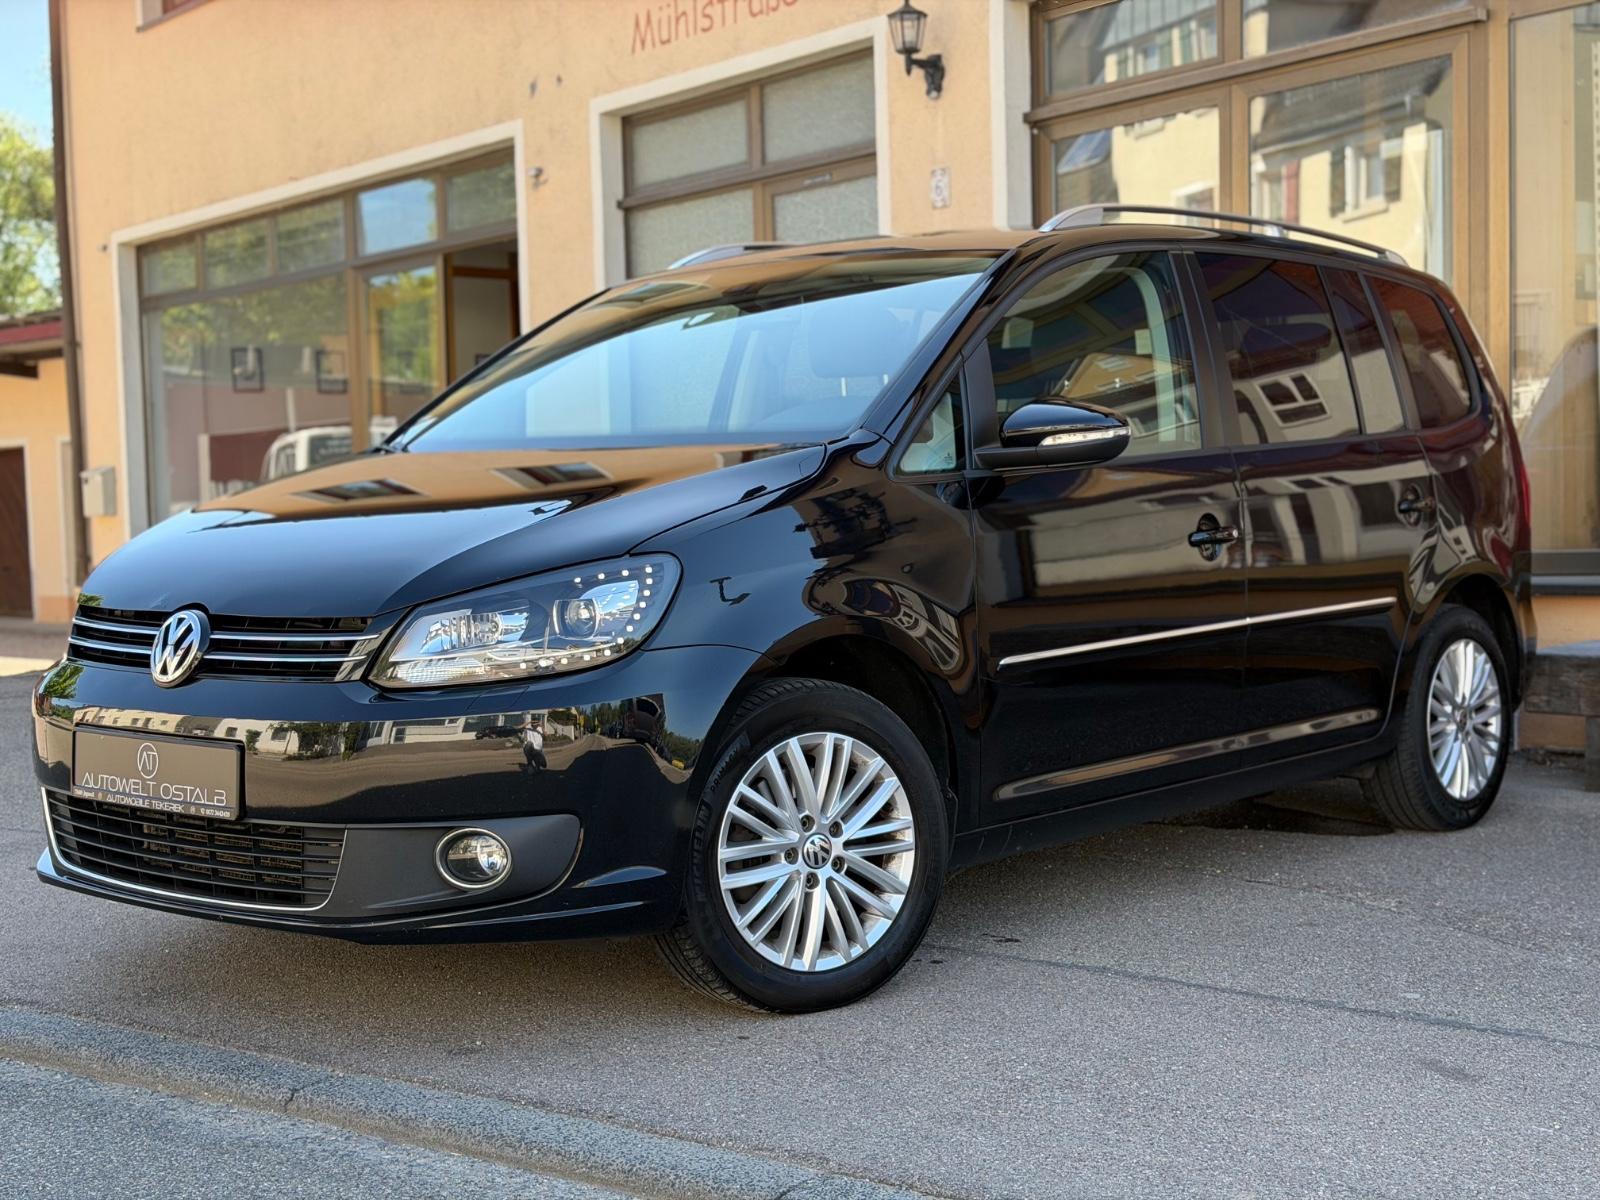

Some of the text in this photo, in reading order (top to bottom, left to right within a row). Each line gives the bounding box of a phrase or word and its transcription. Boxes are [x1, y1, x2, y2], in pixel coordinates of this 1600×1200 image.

[632, 0, 798, 54] Mühlstra
[81, 772, 157, 797] AUTOWELT
[160, 783, 227, 806] OSTALB
[106, 793, 150, 808] AUTOMOBILE
